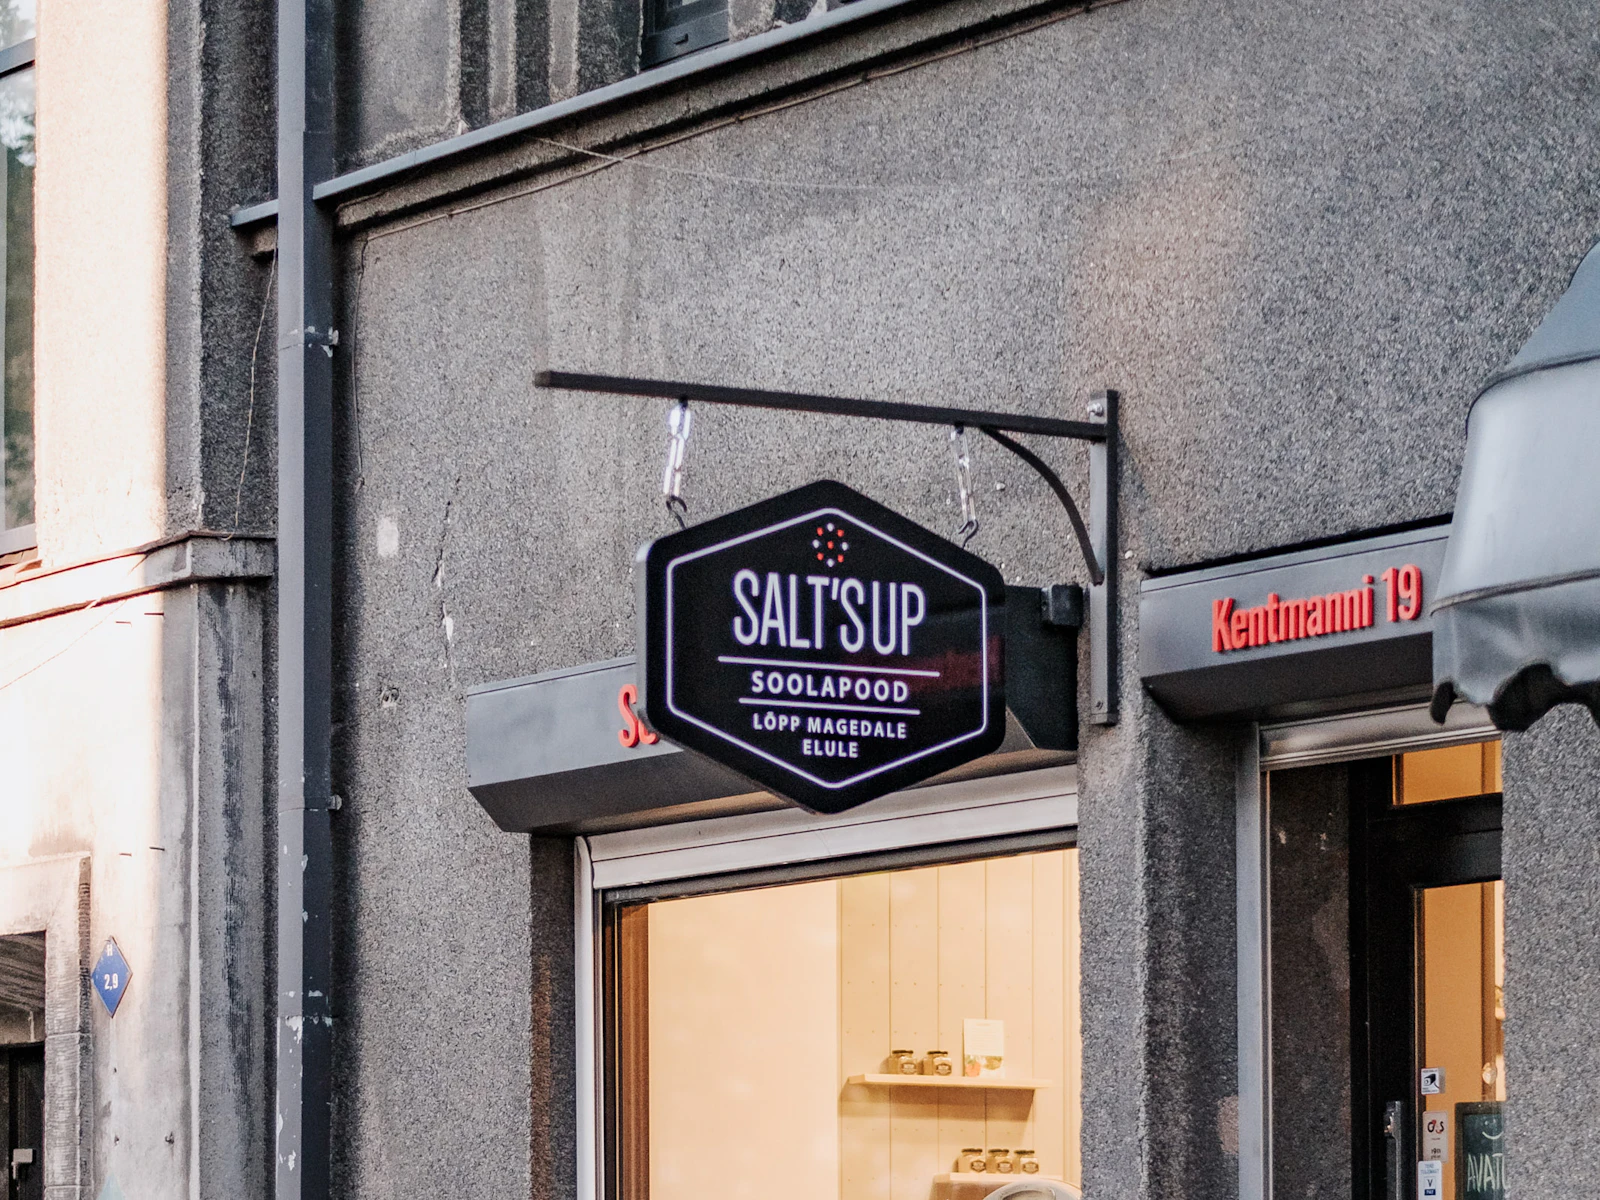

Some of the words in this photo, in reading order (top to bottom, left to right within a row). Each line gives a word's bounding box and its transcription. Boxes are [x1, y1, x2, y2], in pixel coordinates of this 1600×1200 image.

[1212, 574, 1374, 653] Kentmanni
[1381, 563, 1423, 623] 19
[751, 670, 909, 702] SOOLAPOOD
[752, 711, 800, 733] LÕPP
[807, 716, 907, 739] MAGEDALE
[802, 738, 859, 758] ELULE
[106, 944, 113, 957] H
[104, 973, 119, 990] 2,9
